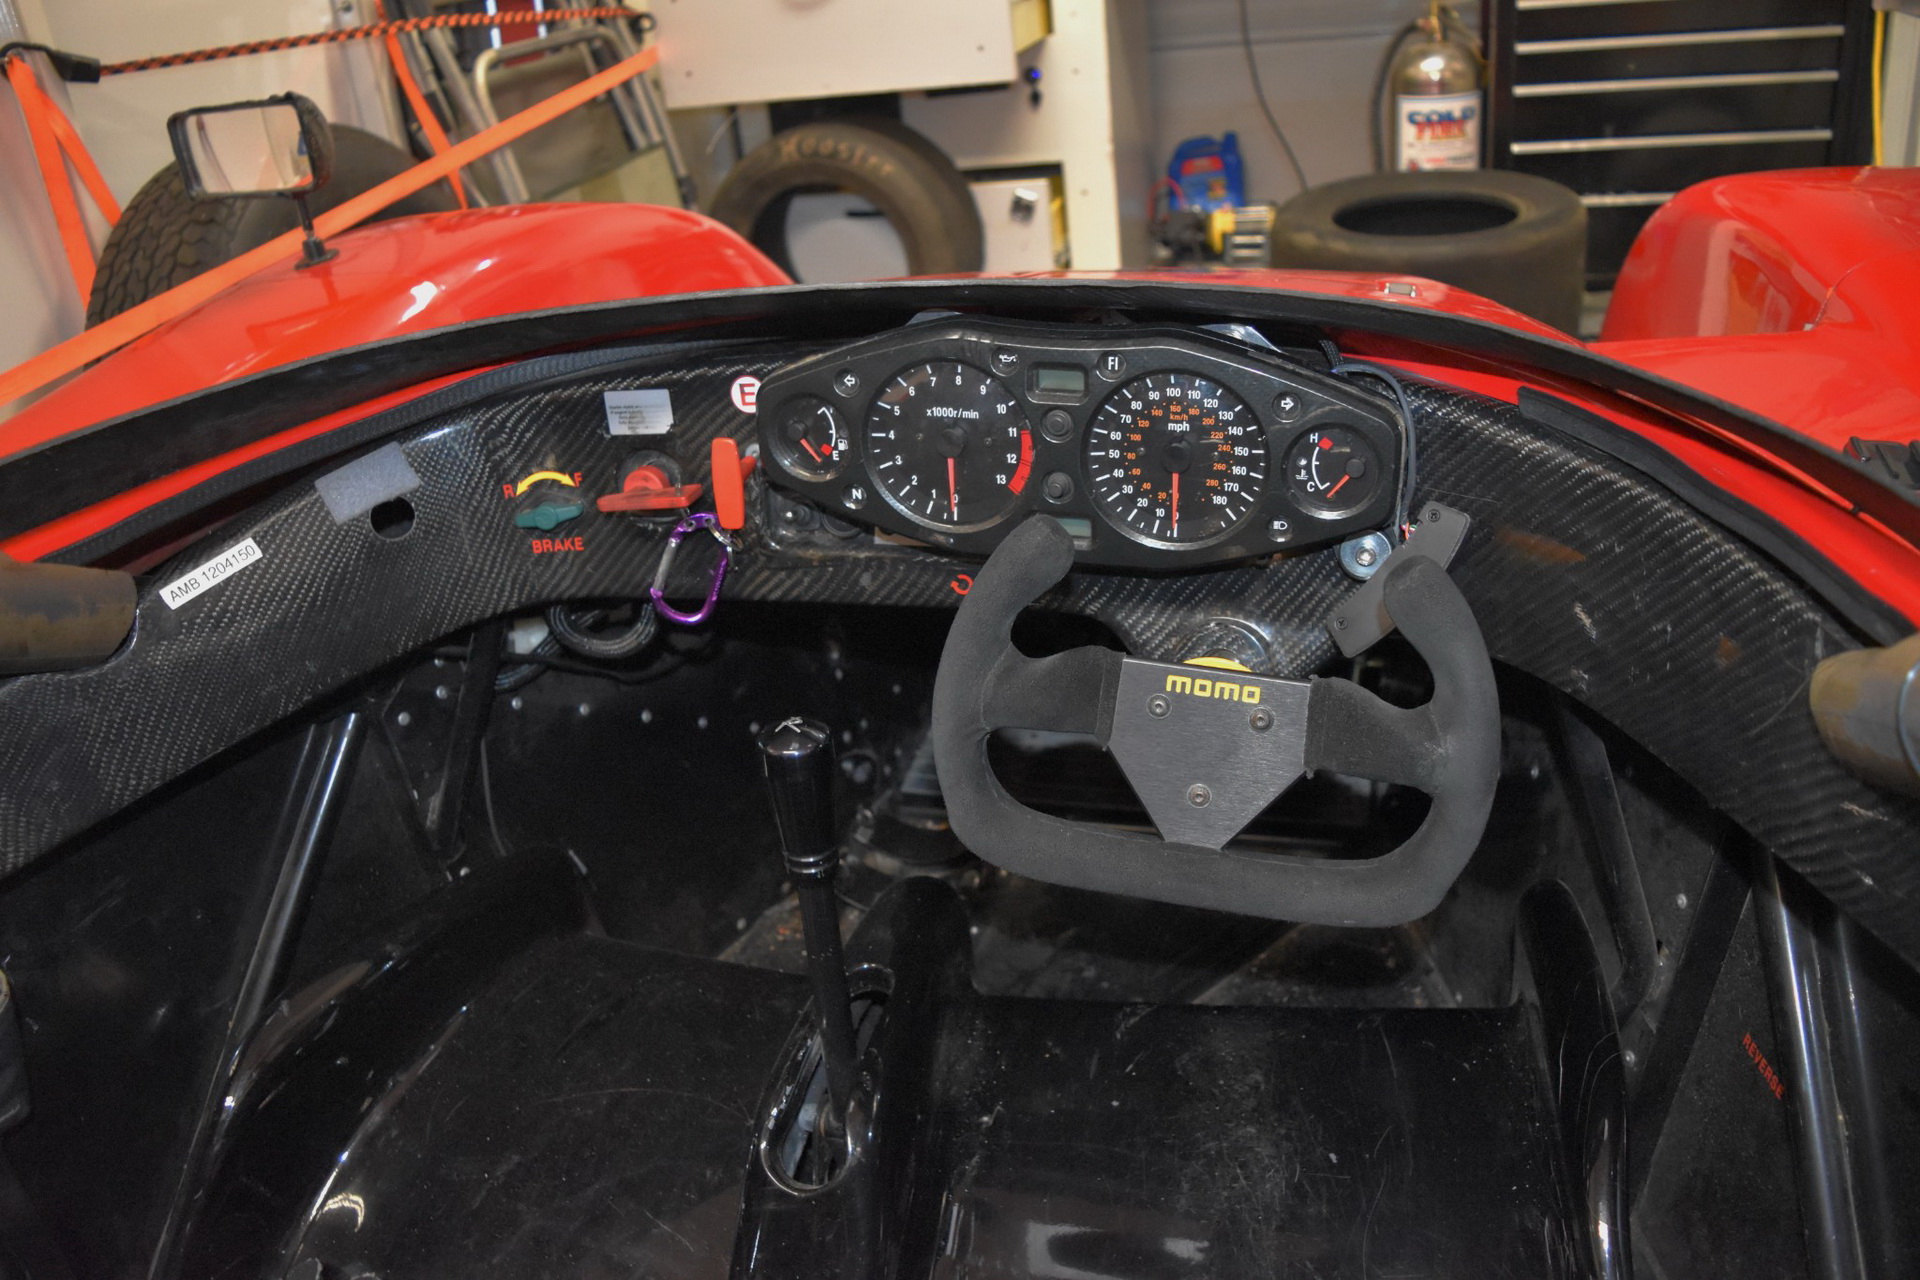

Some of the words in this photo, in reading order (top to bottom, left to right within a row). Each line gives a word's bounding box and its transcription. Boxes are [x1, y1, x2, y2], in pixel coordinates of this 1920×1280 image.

[1108, 356, 1118, 370] FI
[930, 377, 936, 386] 7
[956, 376, 962, 385] 8
[738, 383, 757, 406] E
[909, 386, 915, 396] 6
[980, 385, 986, 395] 9
[1166, 388, 1181, 397] 100
[1187, 390, 1200, 399] 110
[1148, 391, 1159, 400] 90
[1131, 401, 1142, 410] 80
[1203, 398, 1218, 408] 120
[894, 406, 900, 416] 5
[927, 407, 979, 419] x1000r/min
[996, 404, 1006, 414] 10
[1120, 415, 1132, 423] 70
[1218, 411, 1233, 420] 130
[1008, 427, 1017, 437] 11
[1168, 422, 1190, 432] mph
[1228, 426, 1243, 435] 140
[888, 430, 895, 440] 4
[1110, 432, 1121, 440] 60
[1310, 432, 1318, 443] H
[832, 451, 840, 460] E
[1108, 450, 1120, 458] 50
[1234, 447, 1249, 456] 150
[895, 455, 902, 465] 3
[1006, 454, 1016, 463] 12
[1112, 469, 1124, 478] 40
[1232, 466, 1246, 475] 160
[574, 472, 583, 487] F
[911, 476, 918, 485] 2
[996, 474, 1006, 484] 13
[502, 484, 515, 499] R
[1122, 485, 1133, 494] 30
[1224, 482, 1239, 492] 170
[1307, 481, 1315, 492] C
[852, 488, 862, 500] N
[931, 489, 936, 499] 1
[1137, 498, 1148, 507] 20
[1212, 496, 1227, 505] 180
[1155, 508, 1165, 517] 10
[532, 536, 585, 554] BRAKE
[170, 577, 201, 602] AMB
[202, 545, 256, 581] 1204150
[1166, 675, 1261, 704] momo
[1742, 1032, 1784, 1100] REVERSE
